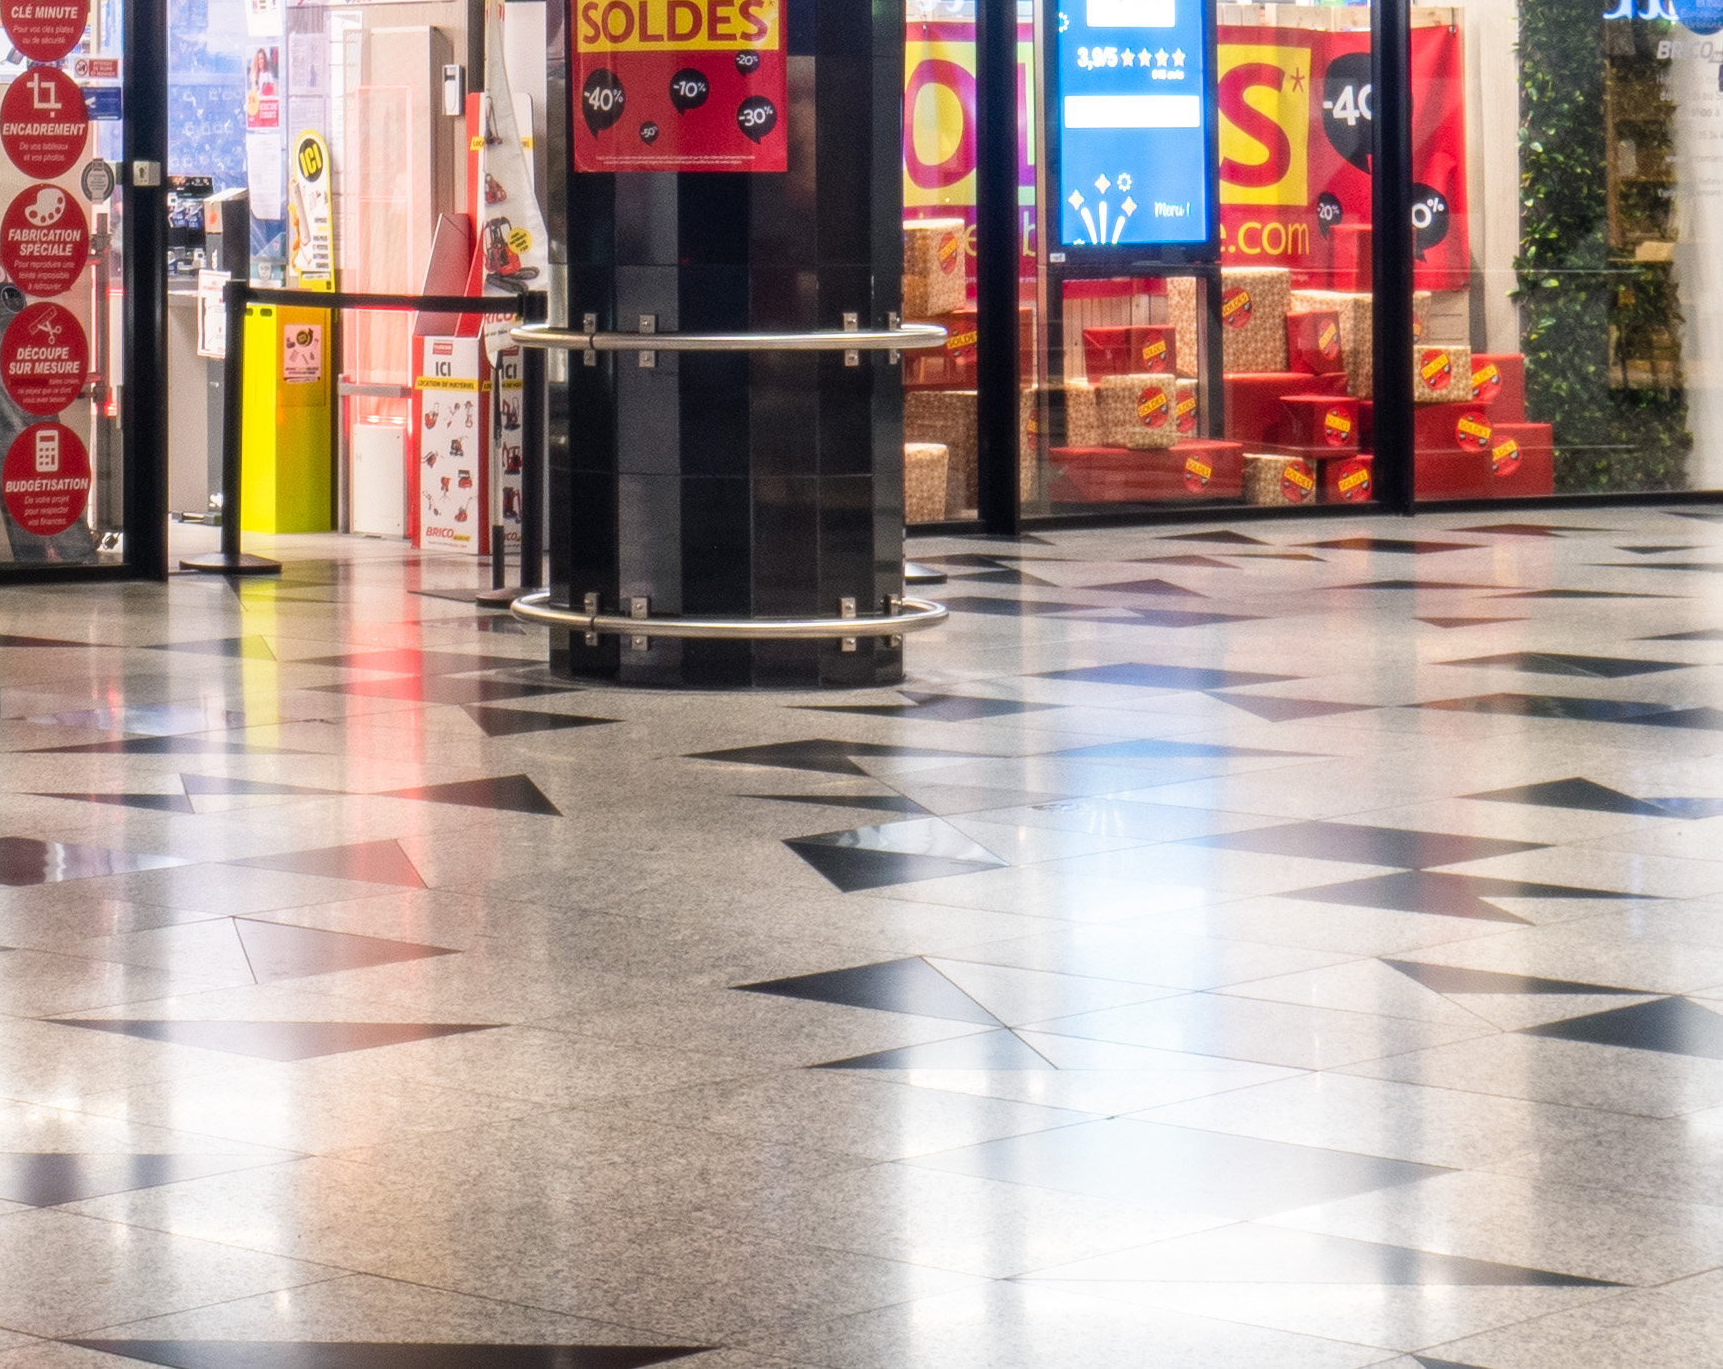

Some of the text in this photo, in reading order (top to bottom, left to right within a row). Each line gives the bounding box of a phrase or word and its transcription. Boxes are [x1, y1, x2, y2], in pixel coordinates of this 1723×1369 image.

[11, 3, 78, 19] CLÉ MINUTE
[1656, 40, 1714, 60] BRCO
[735, 53, 759, 66] -20%
[673, 81, 707, 98] -10%
[583, 86, 624, 112] -40%
[738, 105, 774, 127] -30%
[2, 123, 86, 136] ENCADREMENT
[299, 142, 322, 178] ICI
[1412, 197, 1445, 229] 0%
[8, 229, 81, 242] FABRICATION
[19, 240, 73, 256] SPÉCIALE
[948, 333, 977, 348] SOLDE
[17, 344, 69, 360] DÉCOUPE
[8, 361, 80, 374] SUR MESURE
[435, 361, 451, 377] ICI
[1423, 356, 1447, 377] SOLDES
[1139, 394, 1166, 416] SOLDES
[1460, 421, 1490, 437] SOLDES
[5, 477, 89, 493] BUDGÉTISATION
[1339, 471, 1367, 491] SOLDES
[426, 526, 454, 539] BRICO
